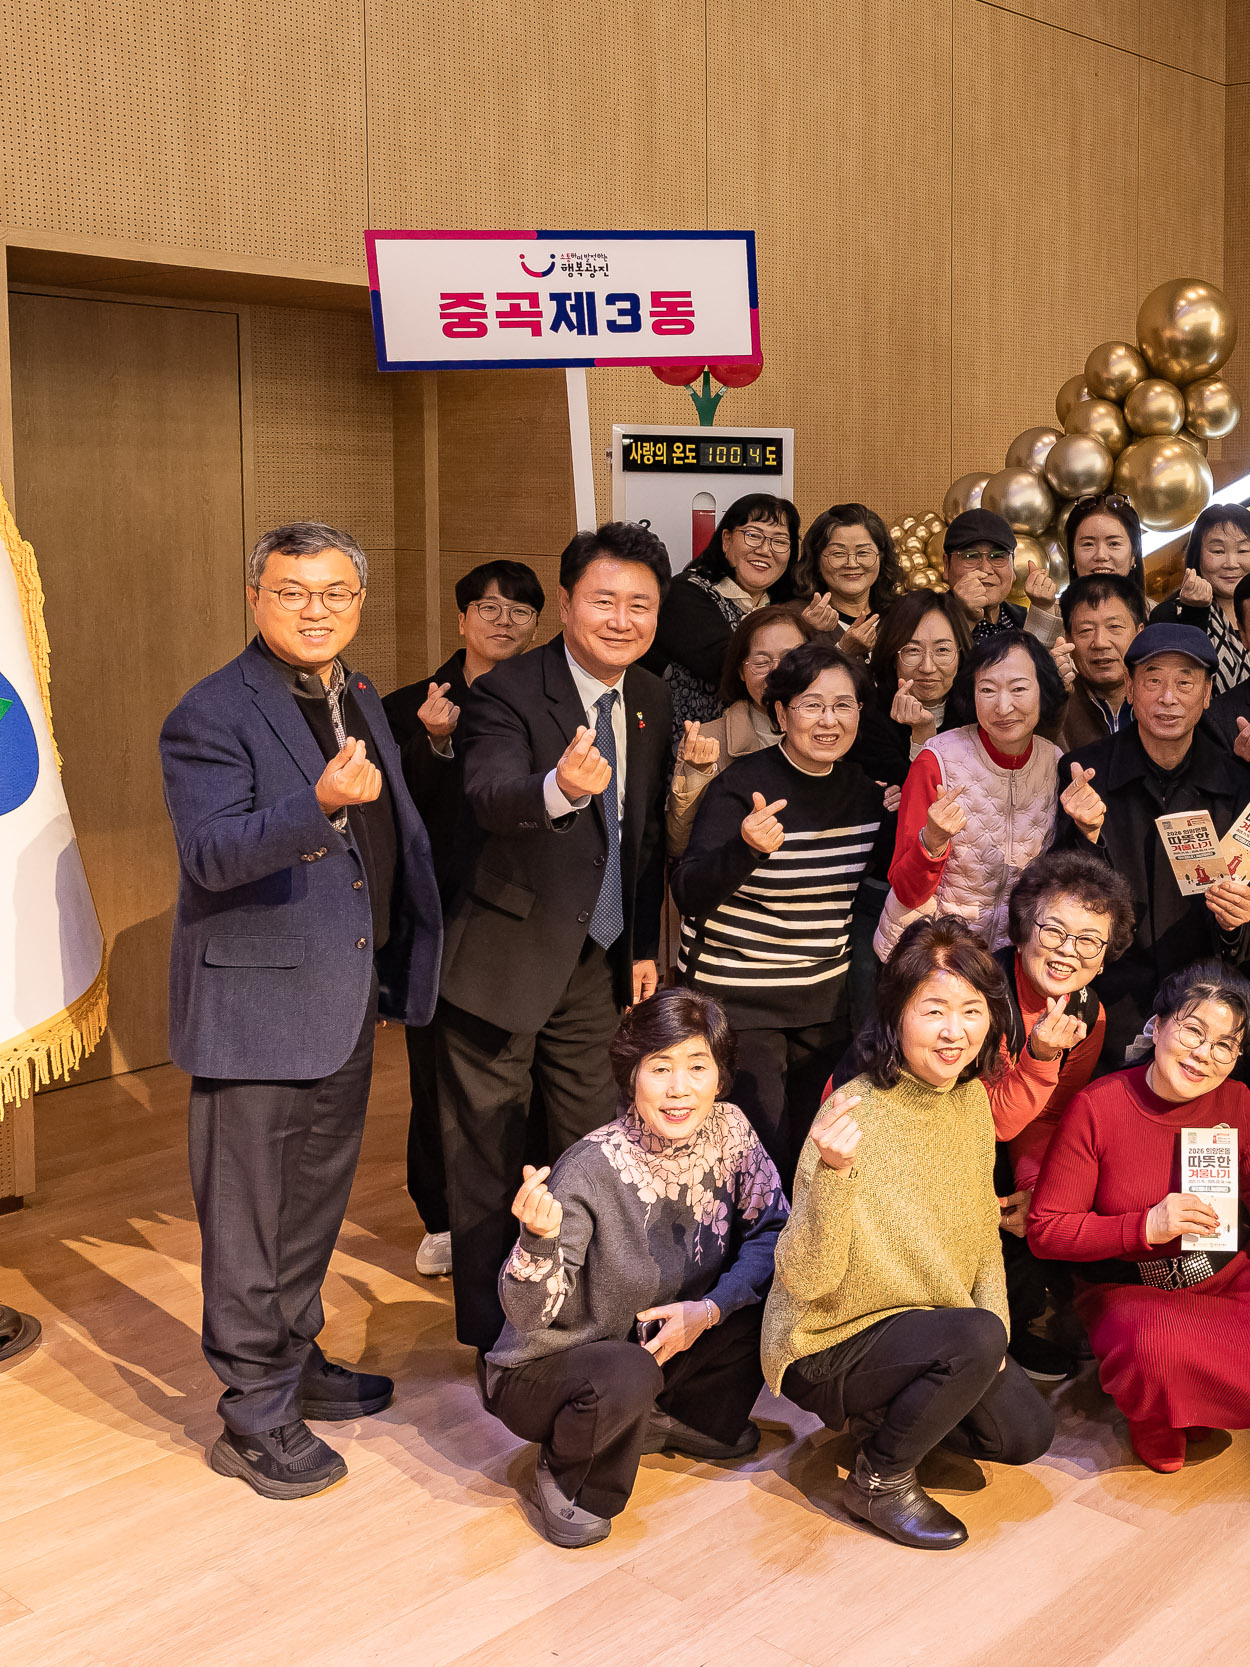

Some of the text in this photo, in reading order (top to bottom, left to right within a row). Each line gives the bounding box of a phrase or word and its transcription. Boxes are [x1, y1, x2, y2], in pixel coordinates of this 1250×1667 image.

[561, 261, 609, 278] 행복광진
[438, 290, 696, 339] 중곡제3동
[629, 441, 667, 465] 사랑의
[672, 442, 697, 465] 온도
[1167, 831, 1210, 845] 따뜻한
[1188, 1147, 1204, 1155] 2026
[1187, 1155, 1231, 1168] 따뜻한
[1188, 1168, 1231, 1179] 겨울나기
